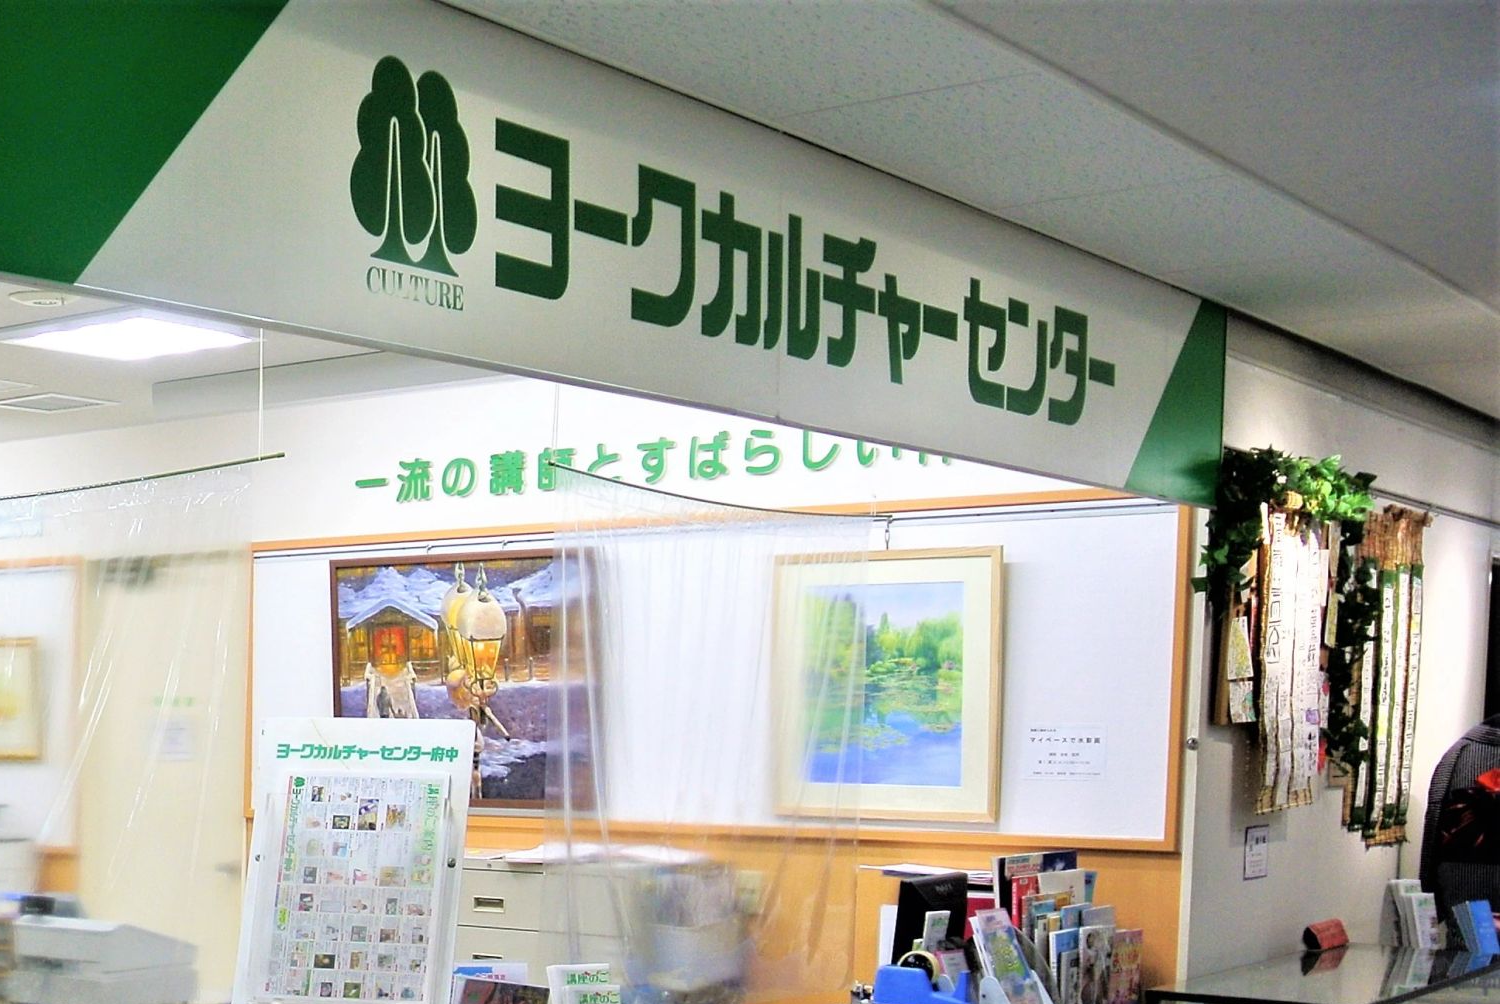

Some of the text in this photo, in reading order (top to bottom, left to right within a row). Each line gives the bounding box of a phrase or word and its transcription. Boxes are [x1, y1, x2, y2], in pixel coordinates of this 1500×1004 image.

[366, 265, 465, 311] CULTURE
[495, 117, 1117, 427] ヨークカルチャーセンター
[354, 428, 951, 503] 一流の講師とすばらしい
[276, 743, 459, 763] ヨークカルチャーセンター府中
